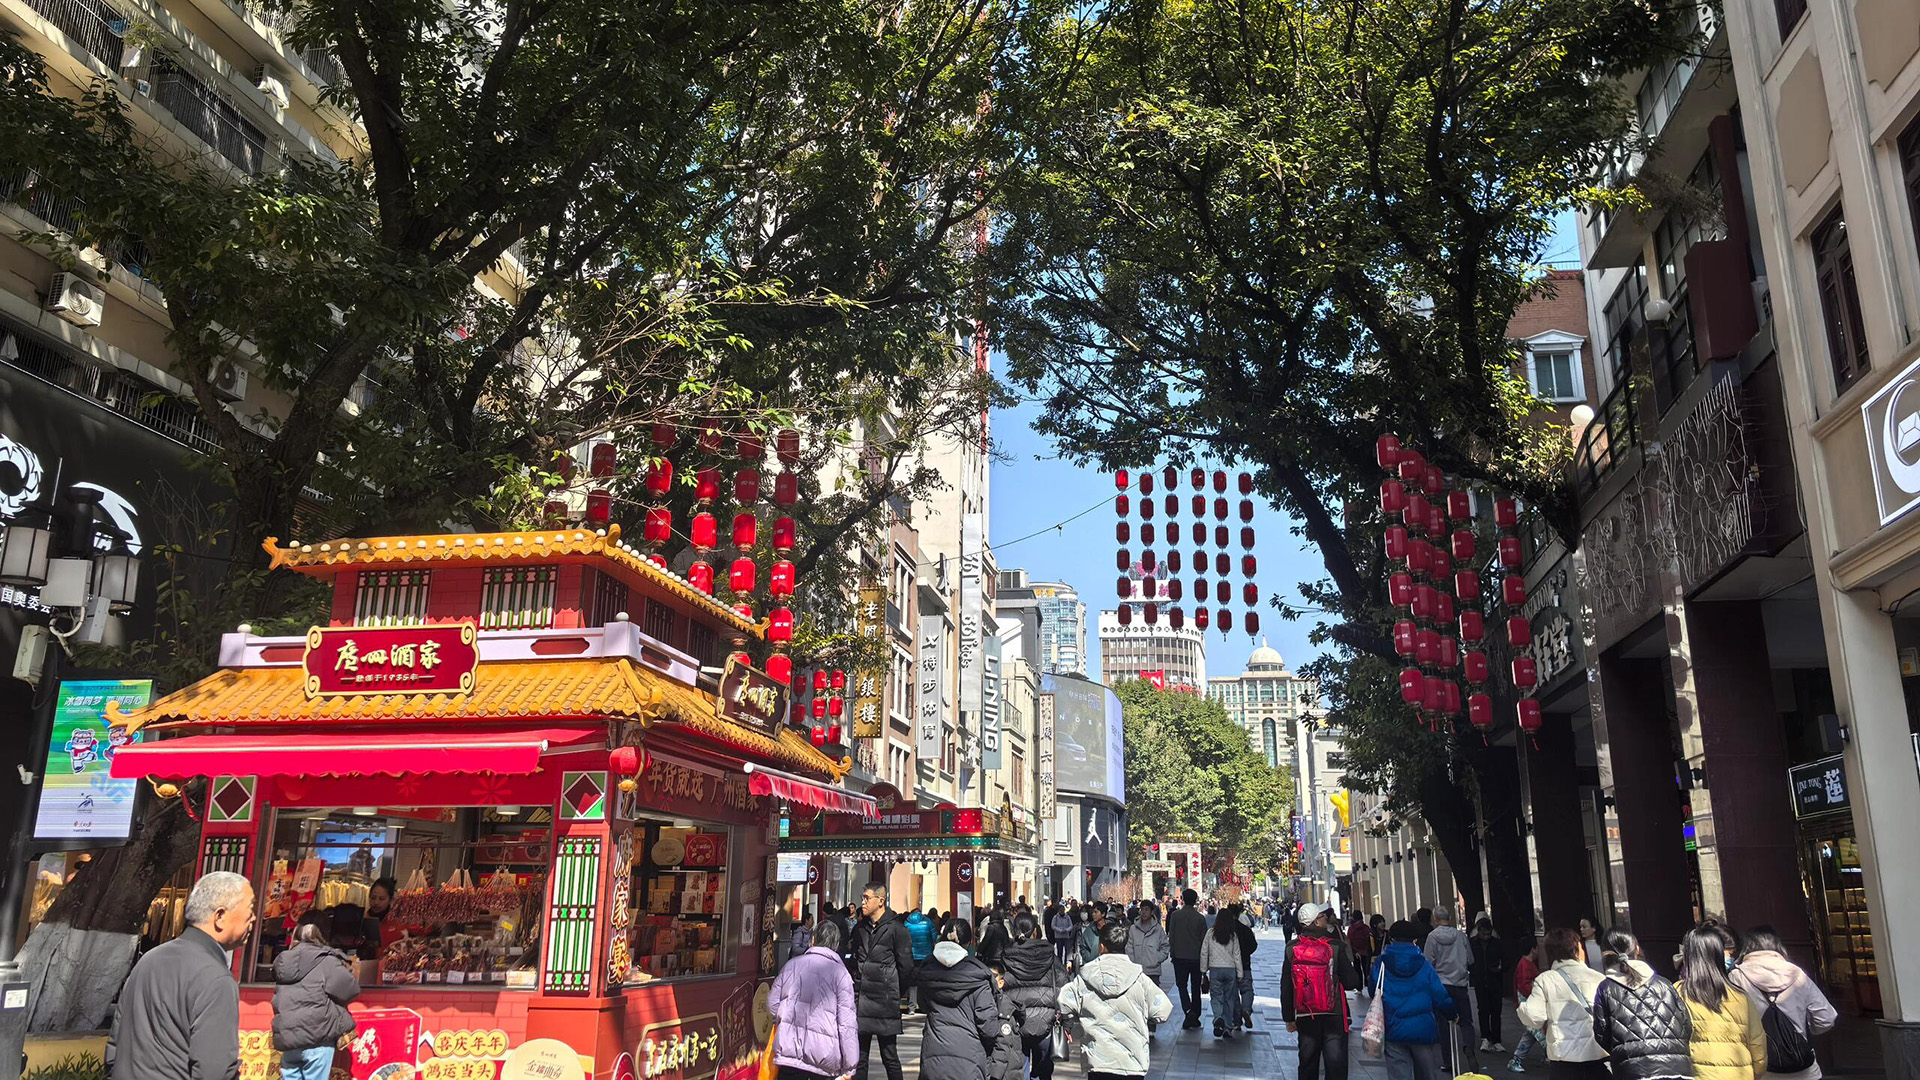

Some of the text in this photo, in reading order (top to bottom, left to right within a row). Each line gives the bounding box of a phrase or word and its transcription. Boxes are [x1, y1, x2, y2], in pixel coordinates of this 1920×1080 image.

[984, 654, 999, 753] LI-NING
[648, 759, 704, 802] 年货就选
[436, 1036, 503, 1052] 喜庆年年
[426, 1063, 491, 1079] 鸿运当头
